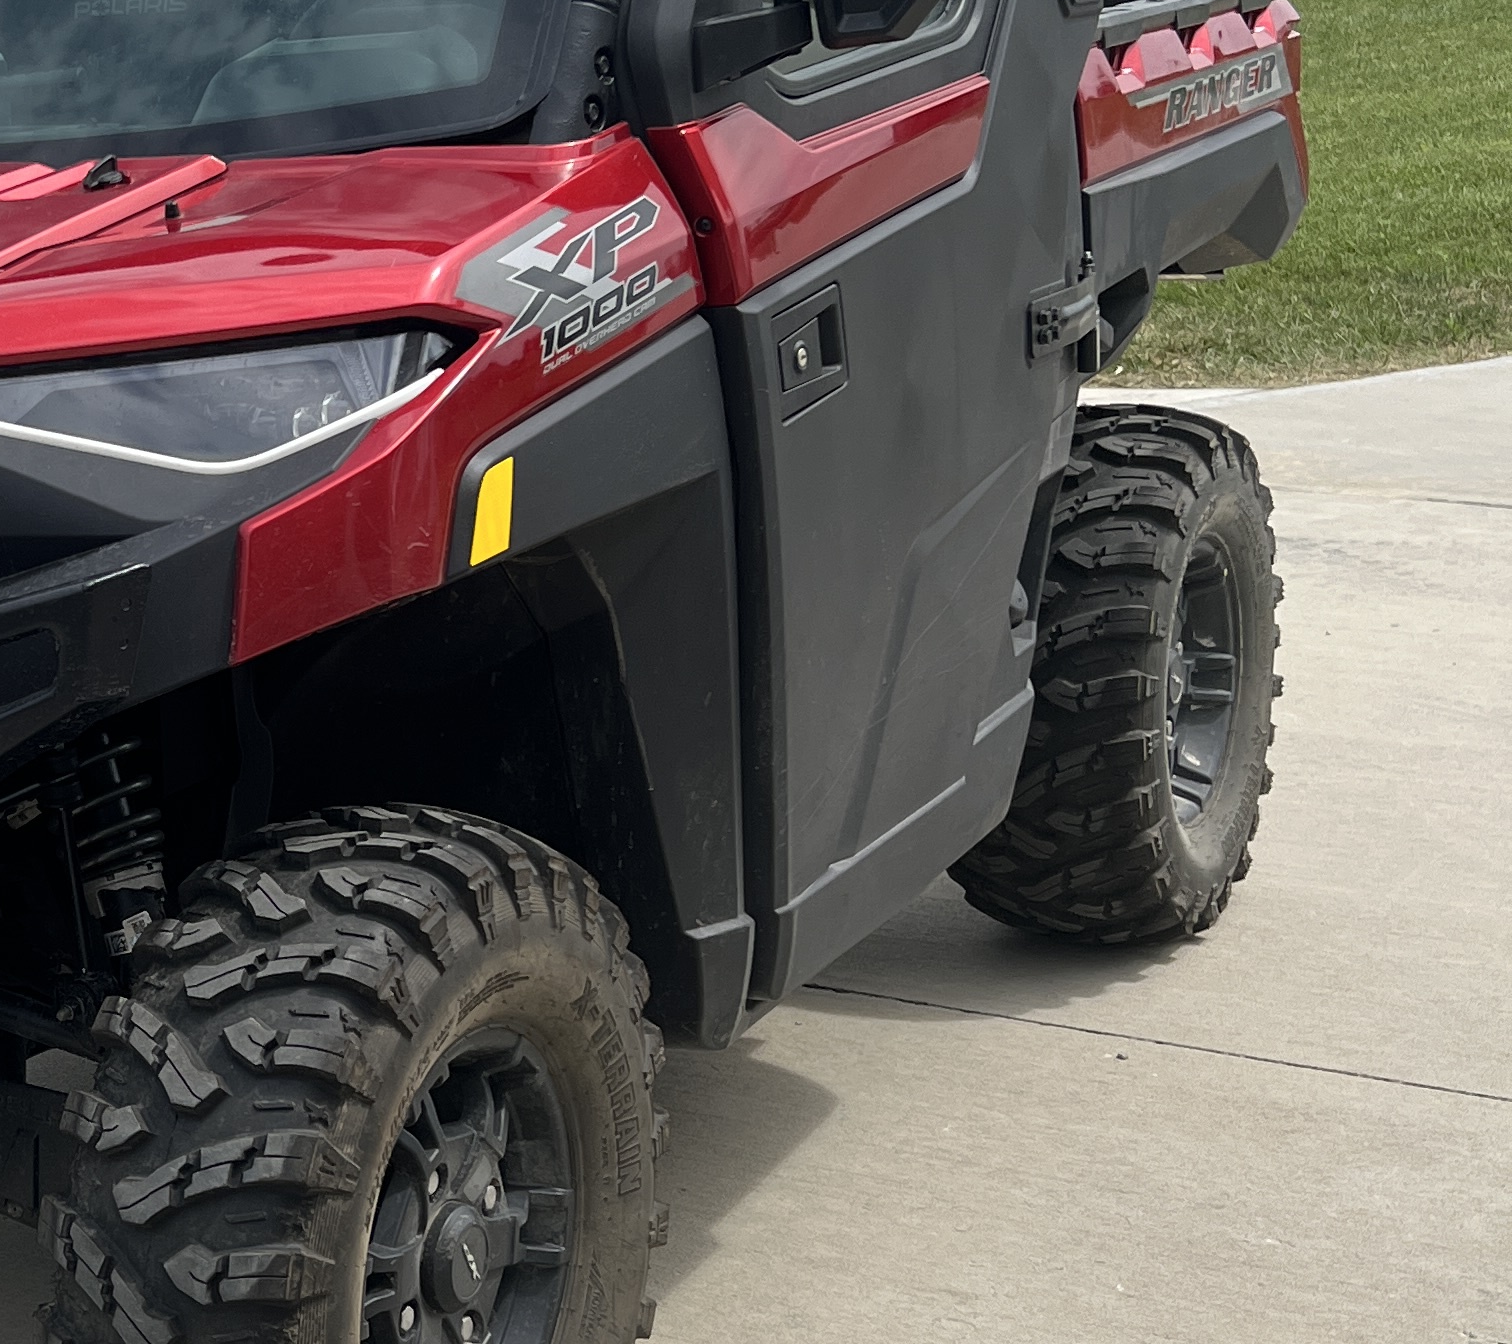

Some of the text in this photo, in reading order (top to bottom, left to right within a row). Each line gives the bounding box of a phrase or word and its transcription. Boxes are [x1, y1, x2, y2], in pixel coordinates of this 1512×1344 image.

[1163, 53, 1276, 133] RANGER
[494, 195, 661, 349] XP
[541, 261, 659, 364] 1000
[543, 296, 657, 375] DUAL OVERHEAD CAM
[569, 976, 642, 1197] X-TERRAIN
